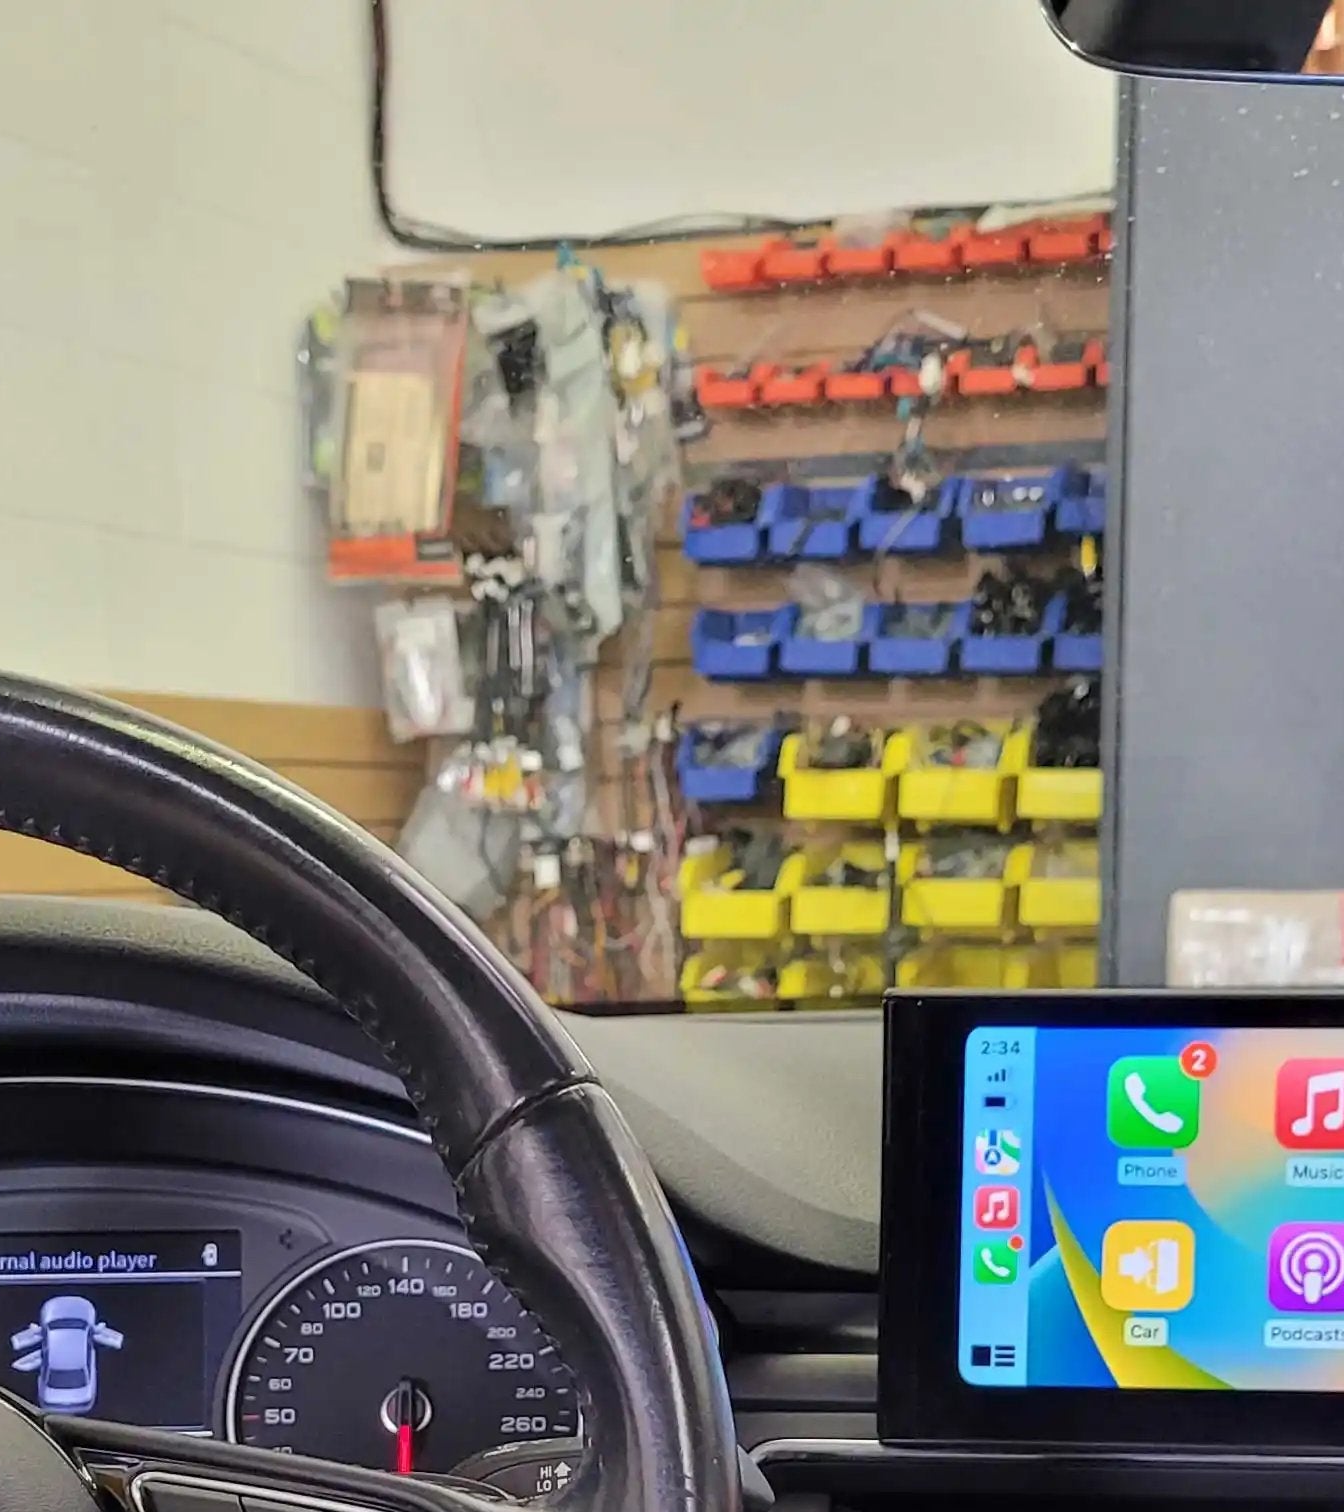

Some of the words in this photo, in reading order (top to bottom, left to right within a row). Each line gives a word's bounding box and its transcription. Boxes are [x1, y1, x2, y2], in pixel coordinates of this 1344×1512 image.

[980, 1040, 1022, 1056] 2:34
[1191, 1050, 1208, 1070] 2
[1124, 1163, 1178, 1180] Phone
[1293, 1164, 1344, 1181] Music
[39, 1250, 94, 1270] audio
[97, 1251, 158, 1273] player
[357, 1285, 382, 1298] 120
[387, 1278, 425, 1295] 140
[432, 1285, 457, 1298] 160
[322, 1302, 362, 1319] 100
[449, 1302, 488, 1319] 180
[300, 1322, 324, 1336] 80
[486, 1326, 517, 1339] 200
[1130, 1324, 1159, 1341] Car
[283, 1347, 315, 1364] 70
[488, 1353, 536, 1370] 220
[268, 1377, 292, 1392] 60
[515, 1386, 546, 1399] 240
[264, 1408, 296, 1425] 50
[500, 1416, 547, 1432] 260
[539, 1465, 553, 1480] HI
[536, 1479, 553, 1493] LO
